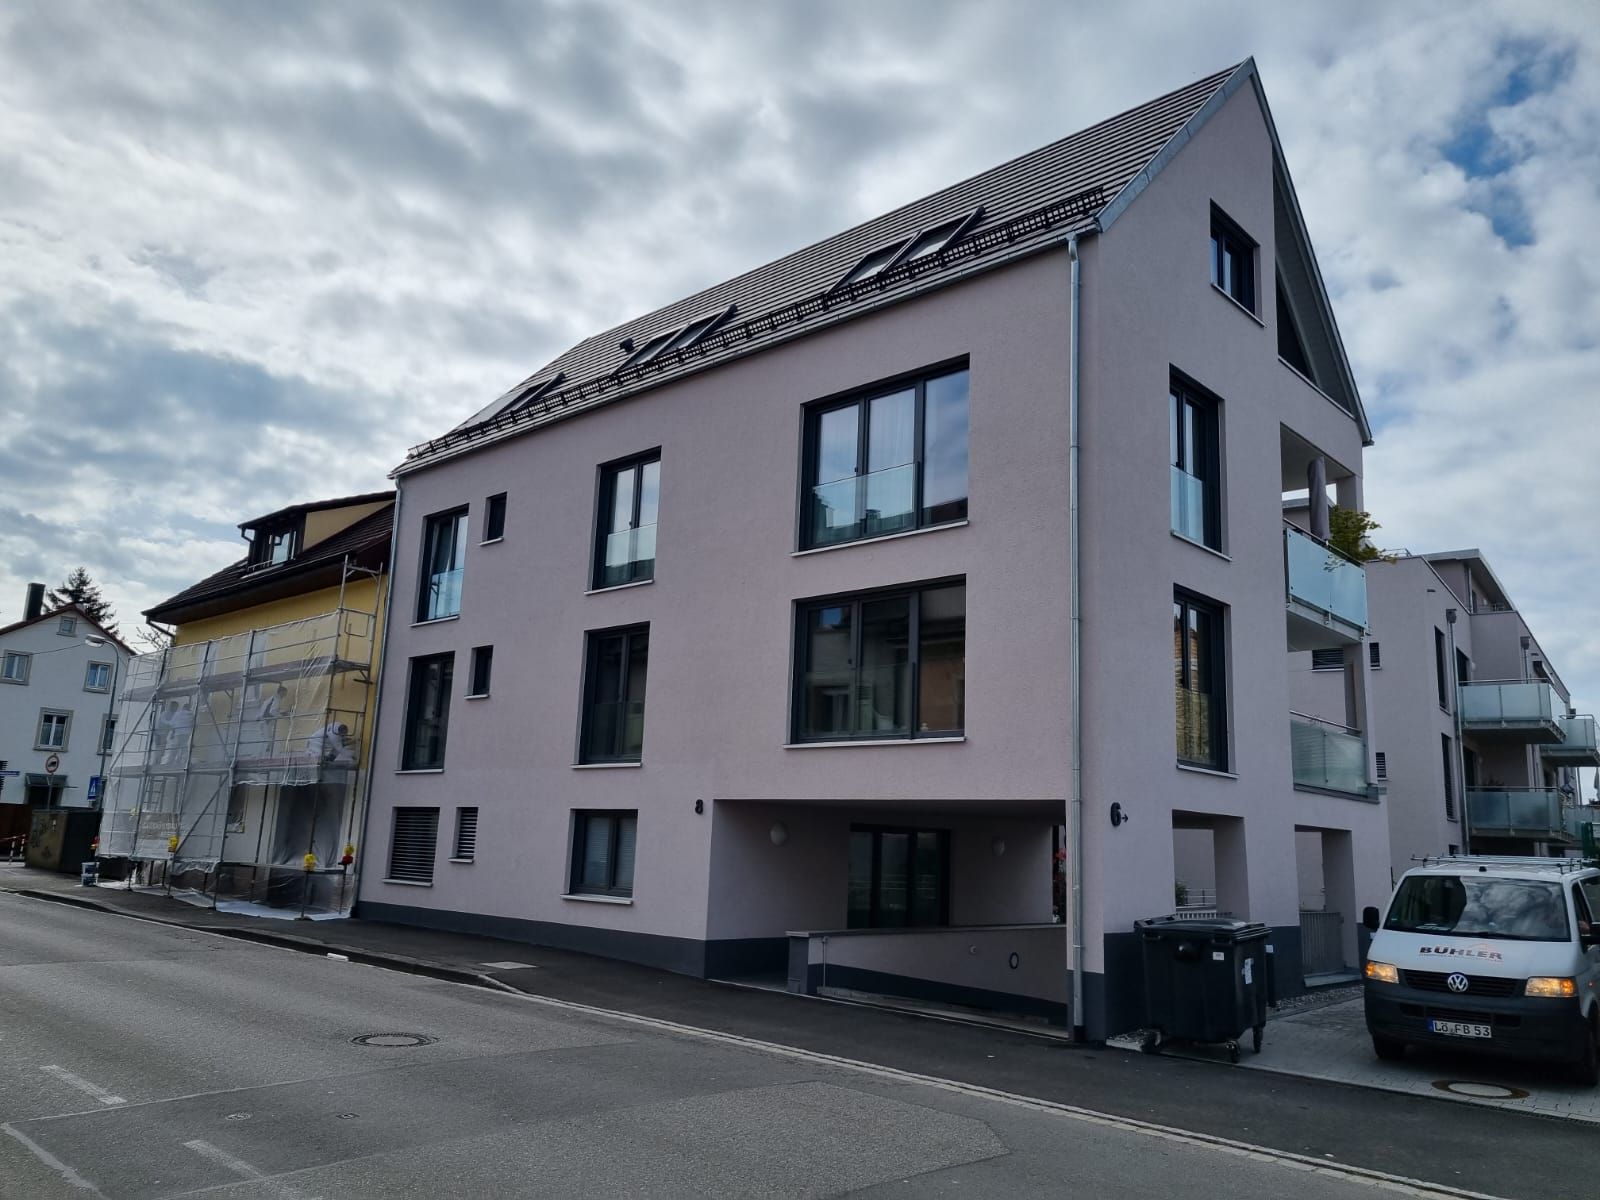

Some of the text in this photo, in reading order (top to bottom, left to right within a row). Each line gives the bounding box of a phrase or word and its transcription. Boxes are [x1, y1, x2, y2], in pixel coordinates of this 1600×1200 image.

[695, 799, 704, 815] 8
[1110, 802, 1122, 827] 6
[1454, 1024, 1471, 1035] FB
[1474, 1026, 1490, 1037] 53
